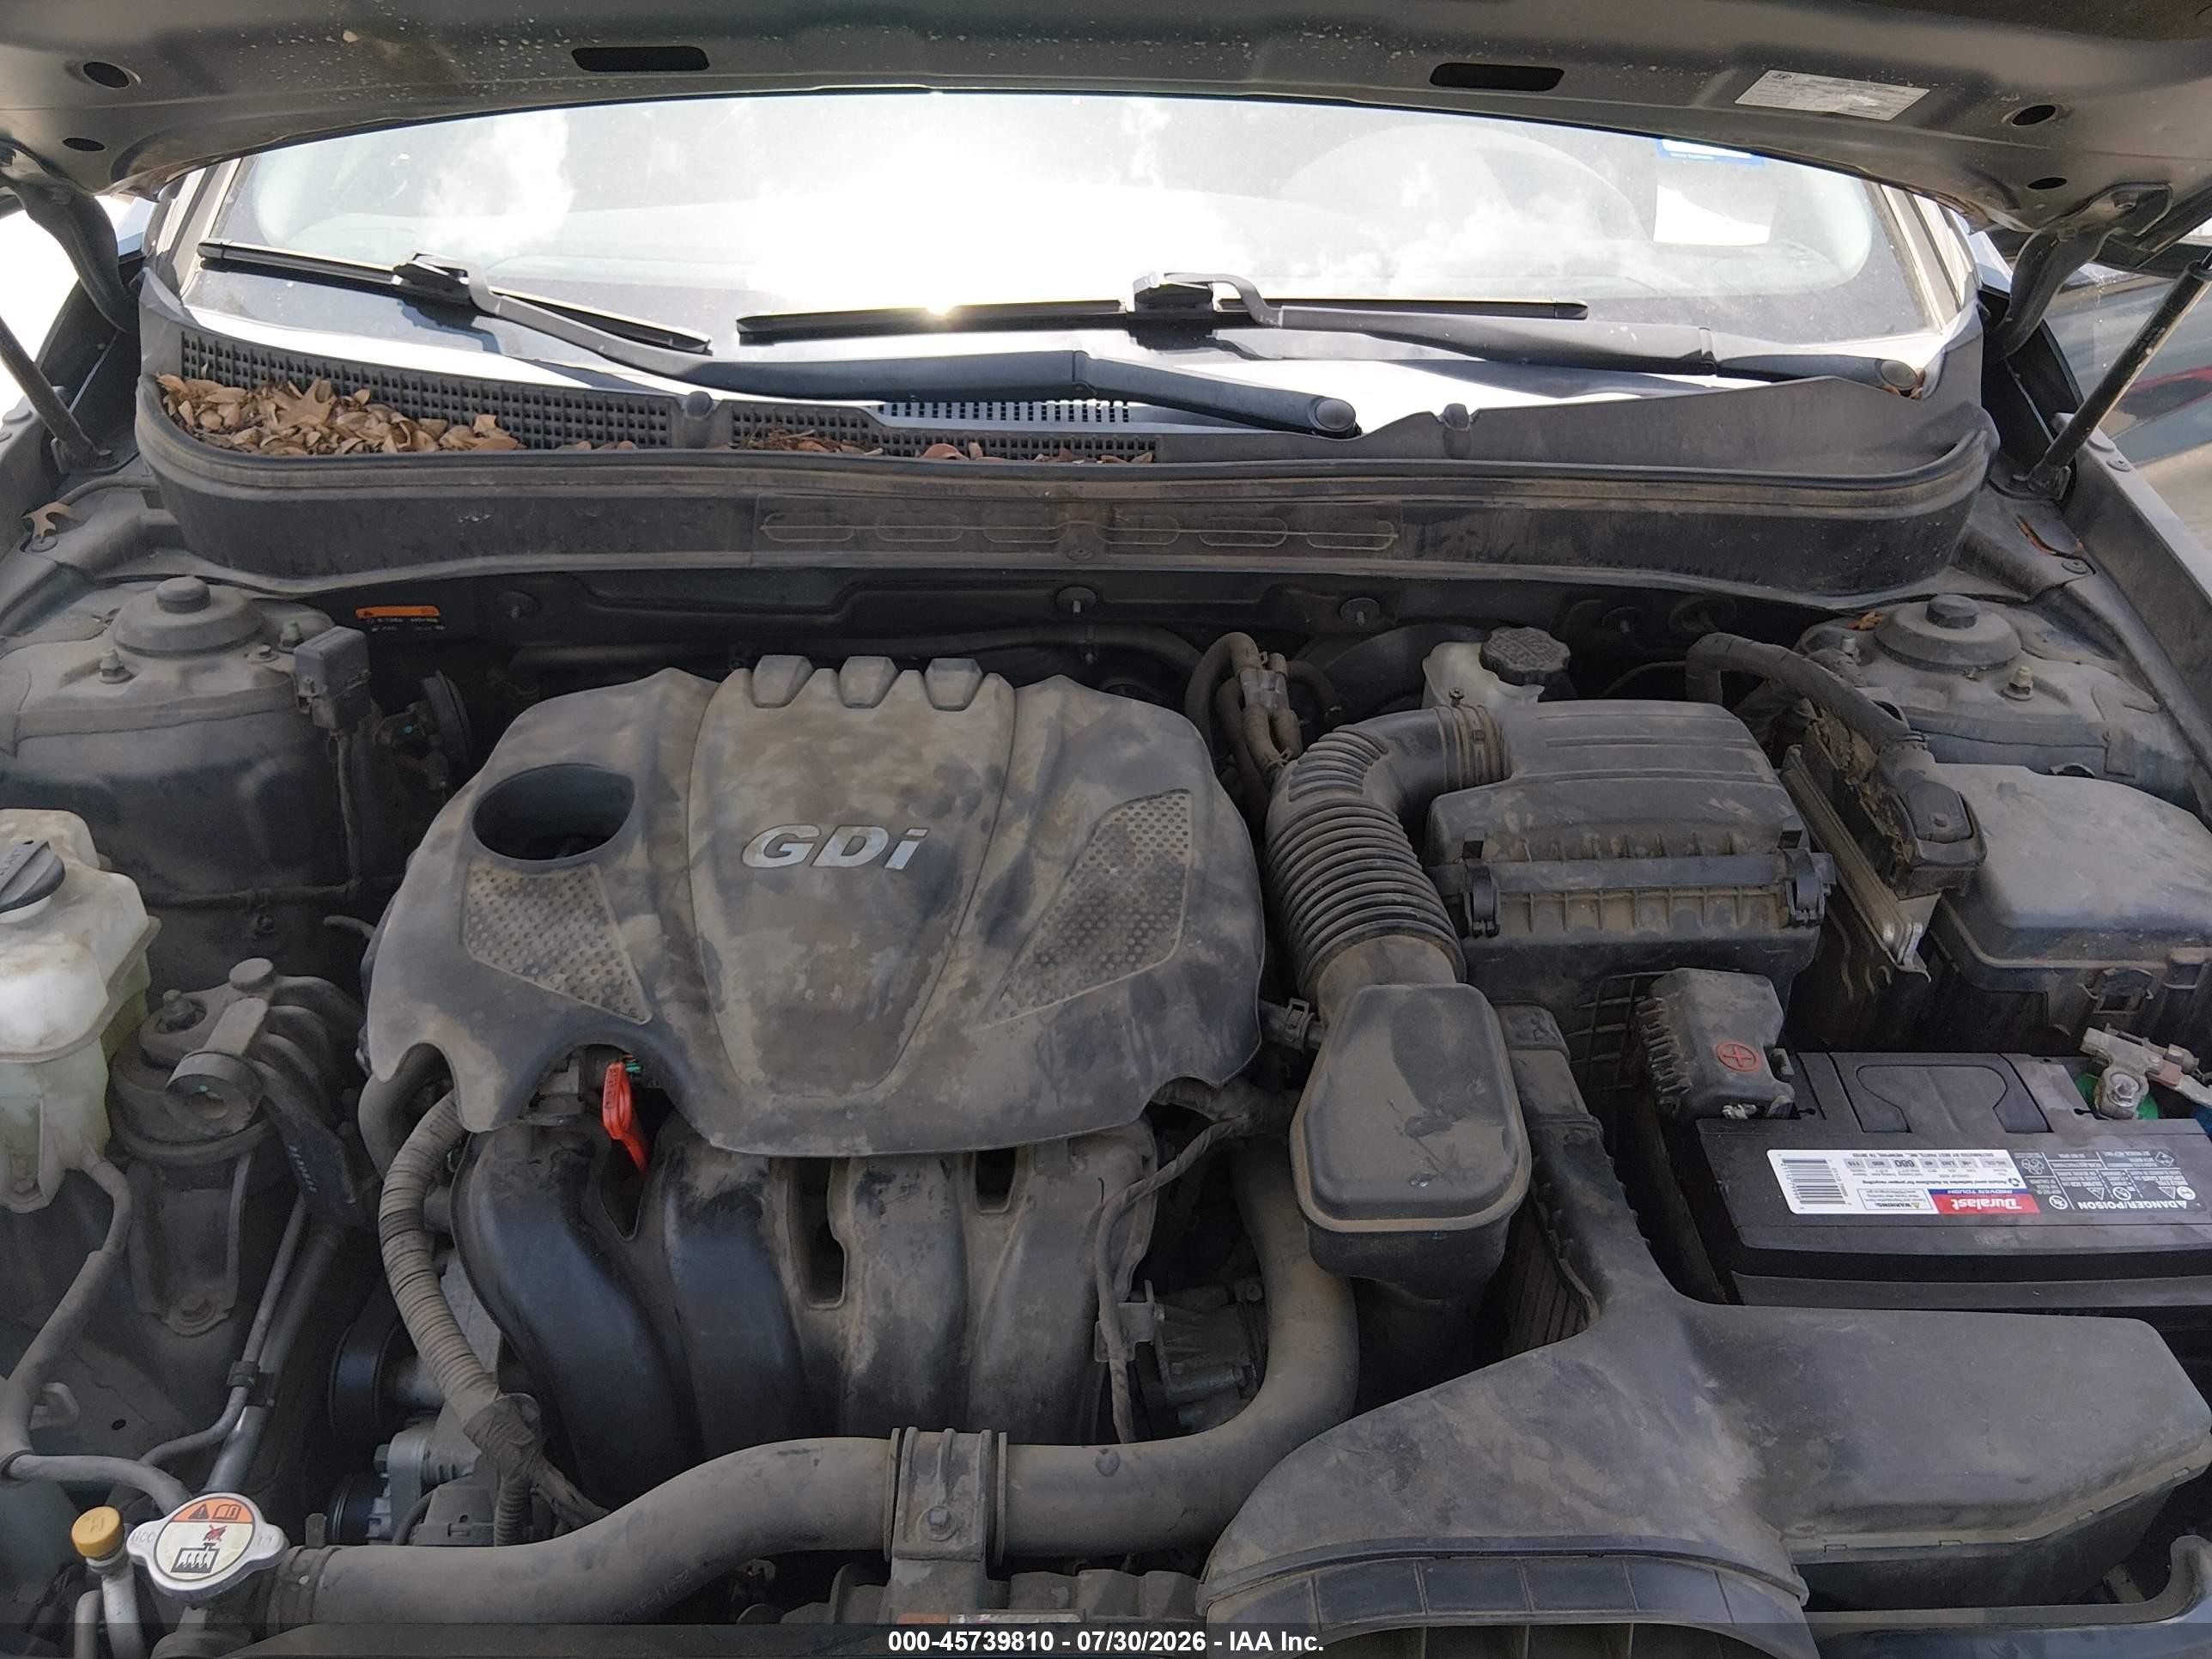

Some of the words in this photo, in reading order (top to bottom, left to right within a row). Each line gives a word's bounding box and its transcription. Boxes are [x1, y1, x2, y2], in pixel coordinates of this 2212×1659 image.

[741, 823, 929, 869] GDi
[1950, 1198, 2022, 1210] Duralast
[2078, 1200, 2181, 1210] DANGER/POISON
